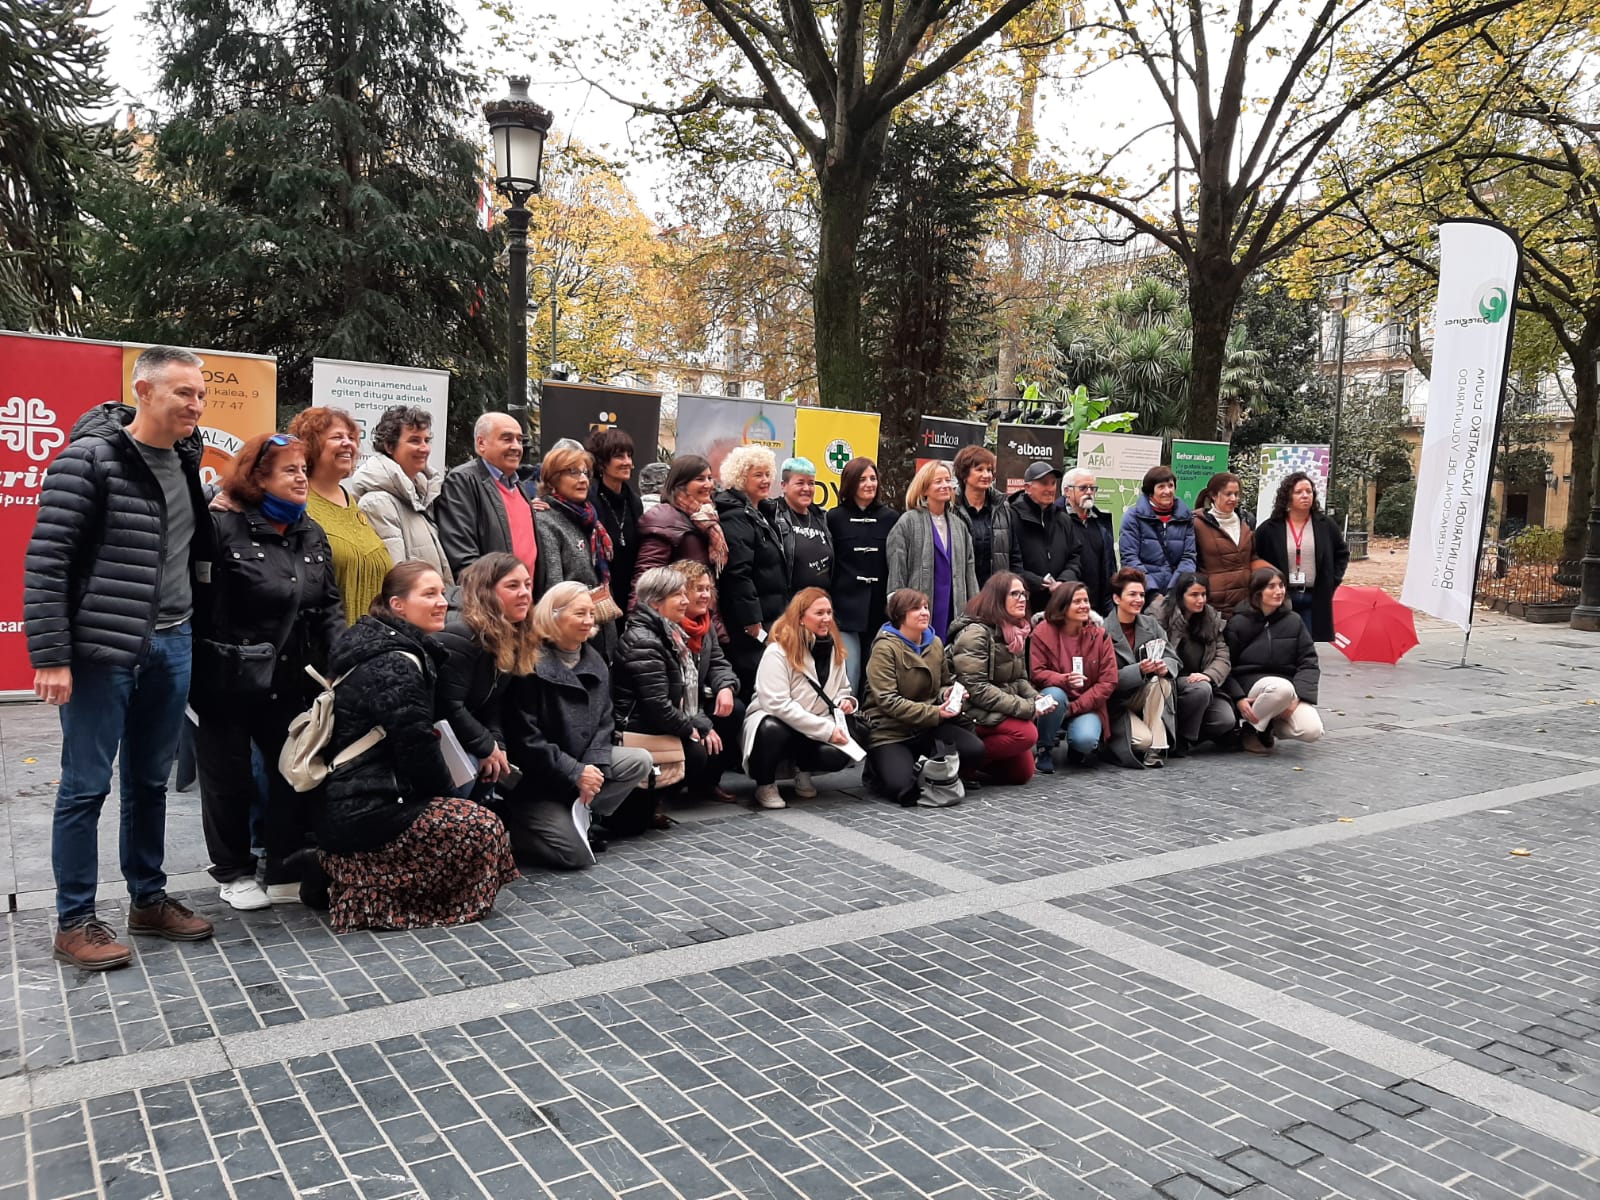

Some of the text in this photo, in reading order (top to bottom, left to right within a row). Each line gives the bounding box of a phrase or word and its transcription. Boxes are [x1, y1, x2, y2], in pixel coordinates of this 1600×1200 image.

[336, 376, 428, 392] Akonpainamenduak
[252, 390, 259, 398] 9
[331, 388, 432, 404] egiten ditugu adineko
[212, 400, 225, 409] 77
[230, 401, 244, 410] 47
[921, 428, 959, 446] Hurkoa
[1017, 443, 1053, 456] alboan
[1087, 454, 1115, 467] AFAGI
